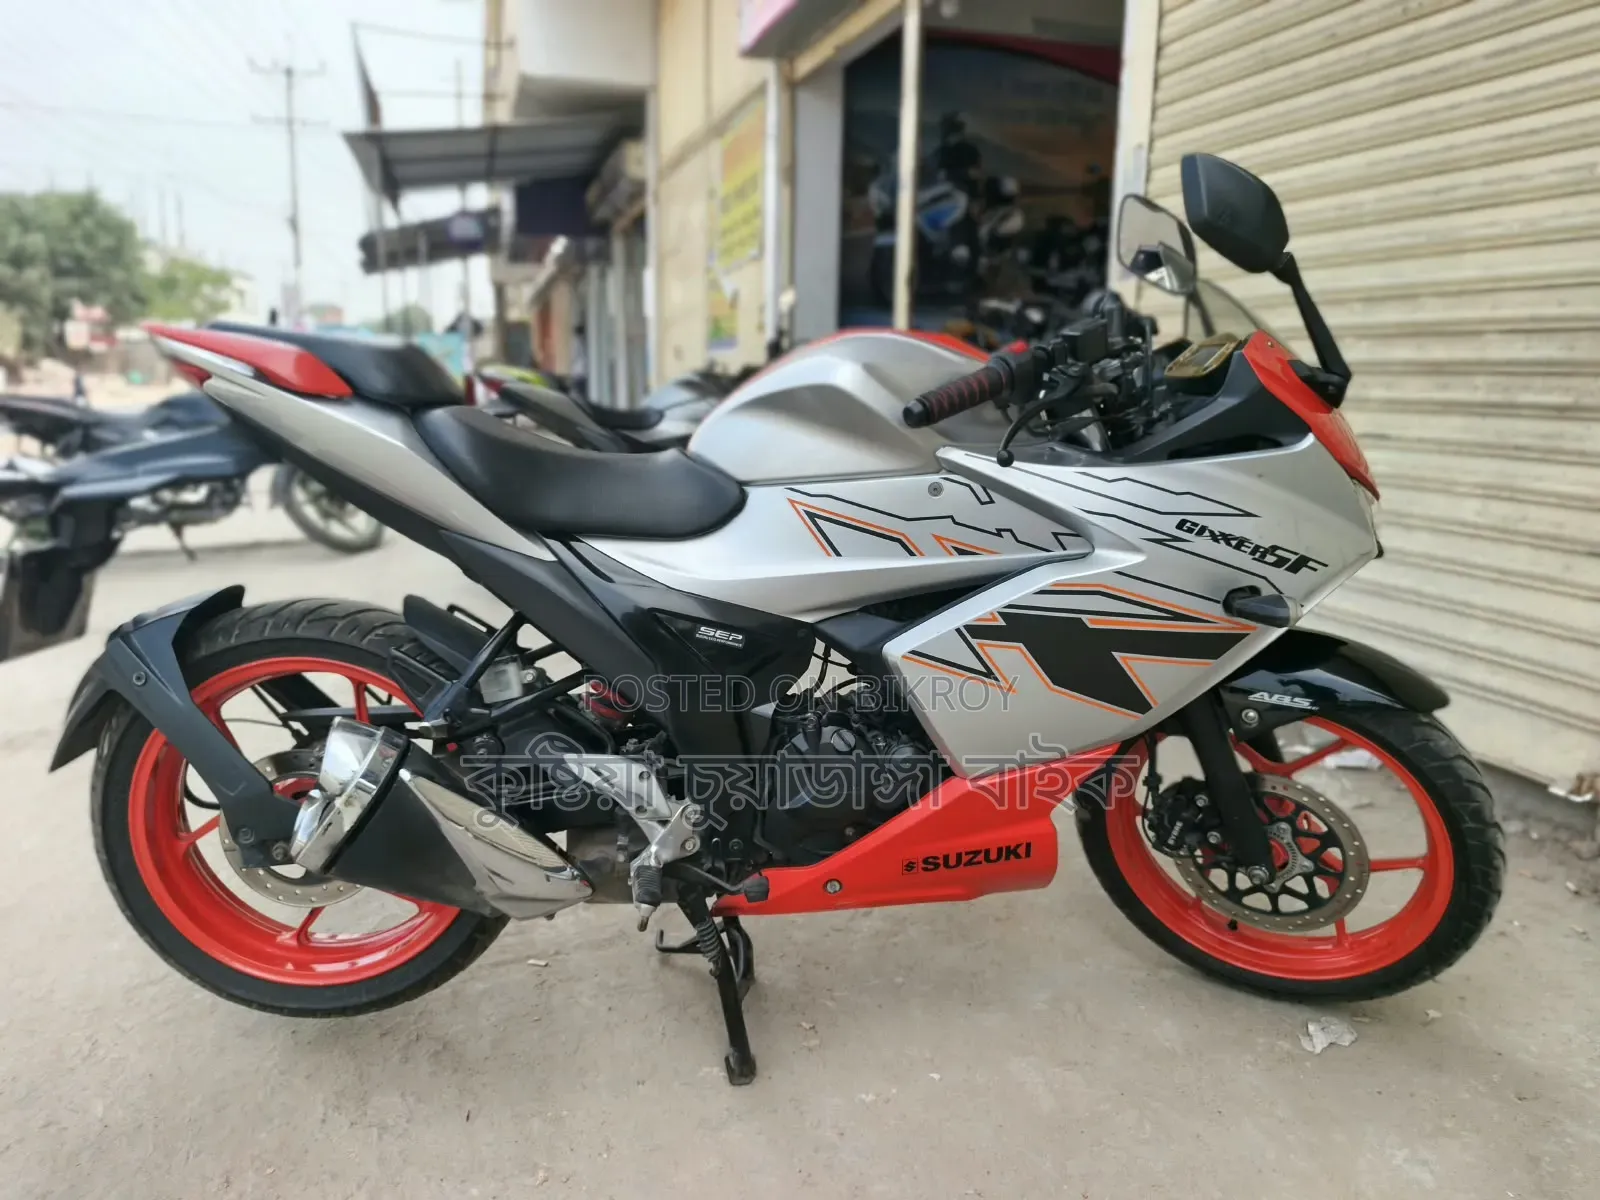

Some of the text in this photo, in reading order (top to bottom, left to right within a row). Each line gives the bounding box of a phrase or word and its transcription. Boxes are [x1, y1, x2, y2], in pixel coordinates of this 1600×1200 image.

[1175, 518, 1329, 575] GIXXER SF
[698, 626, 743, 641] SEP
[1247, 691, 1314, 707] ABS
[921, 841, 1032, 872] SUZUKI
